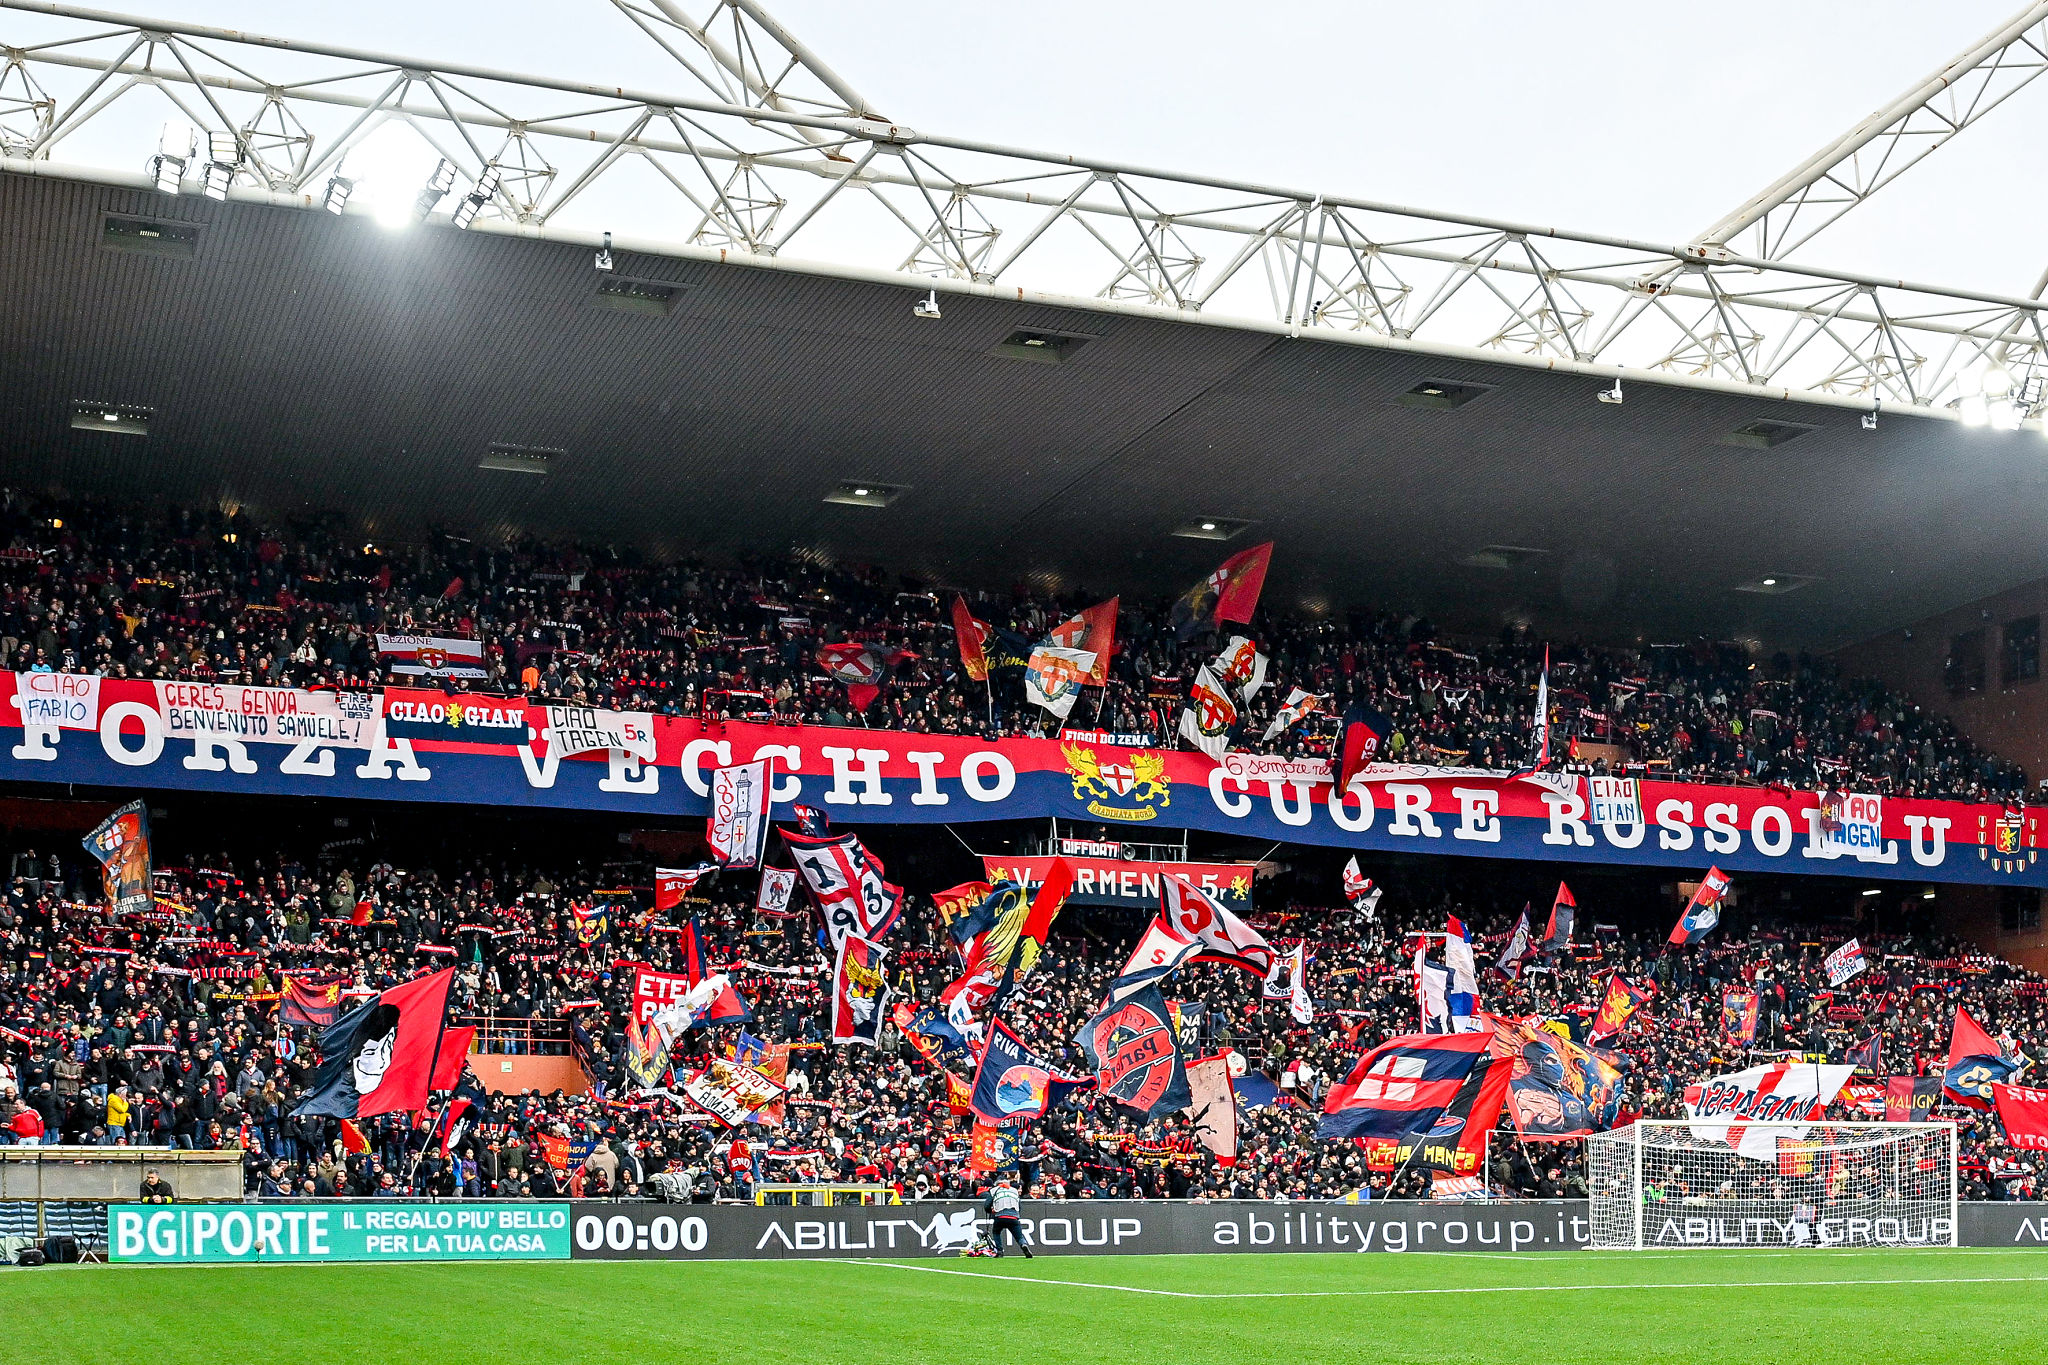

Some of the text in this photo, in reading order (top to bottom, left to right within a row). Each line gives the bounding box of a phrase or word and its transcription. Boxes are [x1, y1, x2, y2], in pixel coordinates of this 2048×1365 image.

[382, 635, 433, 646] SEZIONE
[31, 674, 90, 697] CIAO
[339, 703, 373, 712] CLASS
[341, 694, 368, 703] FIRS
[28, 699, 87, 721] FABIO
[344, 711, 370, 720] 1893
[390, 701, 525, 728] CIAO GIAN
[552, 707, 597, 729] CIAO
[170, 708, 267, 735] BENVENUTO
[556, 730, 623, 751] TAGEN
[1099, 732, 1115, 745] DO
[1117, 733, 1151, 746] ZENA
[1248, 758, 1307, 778] sempre
[1593, 780, 1633, 798] CIAO
[1208, 766, 1500, 843] CUORE
[1063, 840, 1119, 858] DIFFIDATI
[639, 973, 691, 1000] ETE
[994, 1031, 1020, 1060] RIVA
[557, 1143, 587, 1155] BANDA
[344, 1211, 565, 1230] IL REGALO PIU' BELLO
[1656, 1217, 1797, 1243] ABILITY
[575, 1214, 708, 1251] 00:00
[755, 1218, 938, 1250] ABILITY
[1213, 1211, 1590, 1252] abilitygroup.it
[366, 1233, 545, 1253] PER LA TUA CASA
